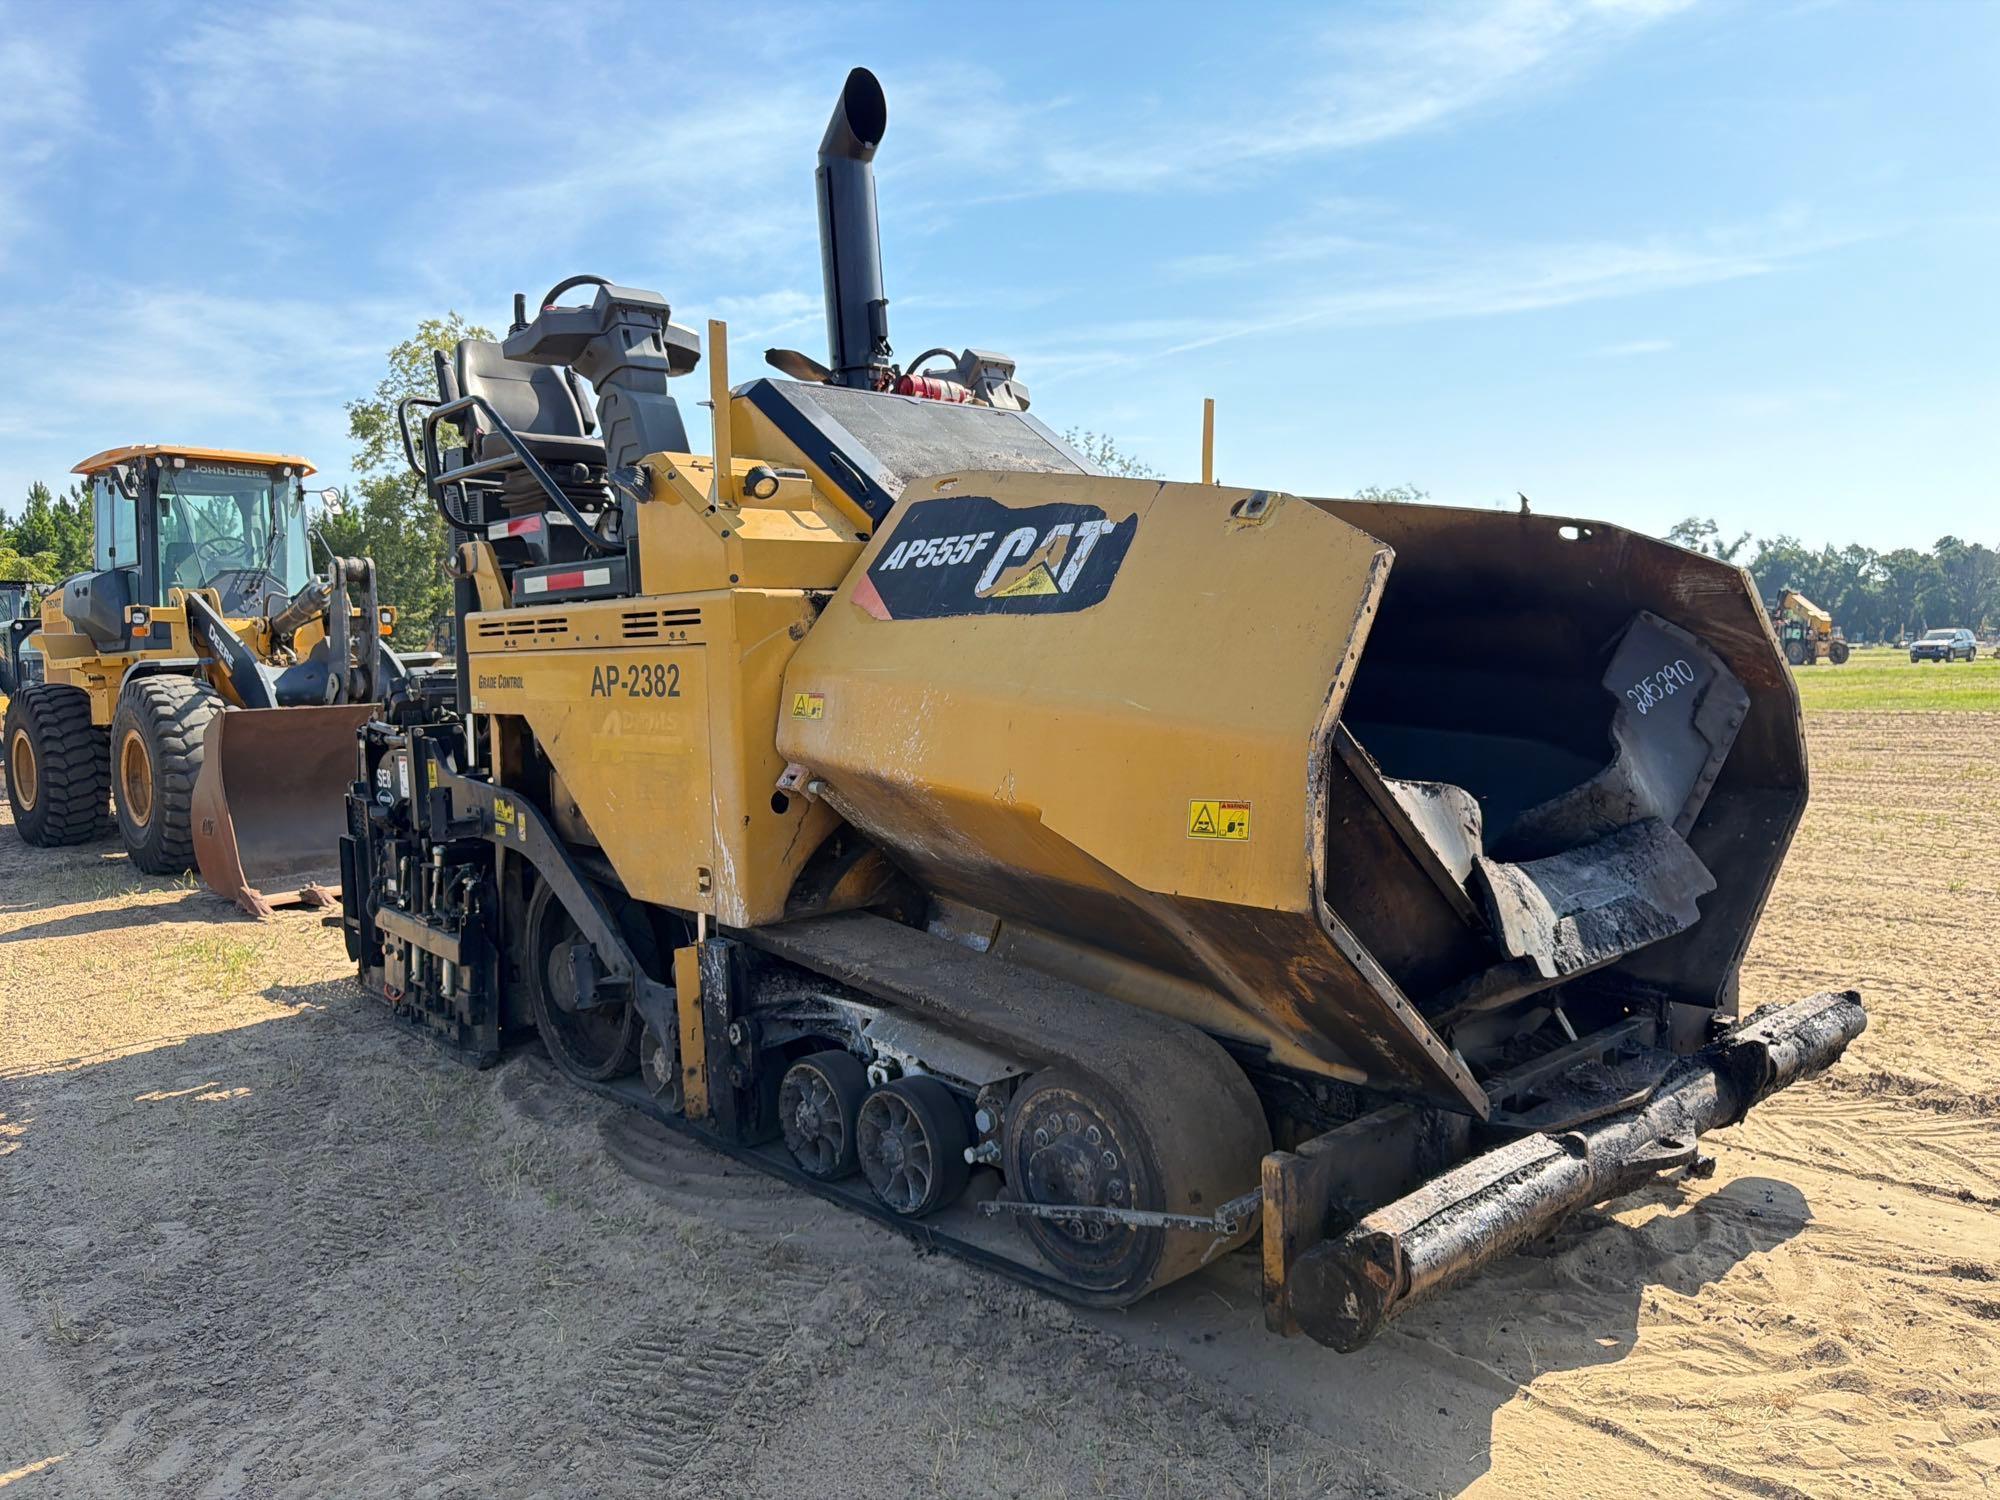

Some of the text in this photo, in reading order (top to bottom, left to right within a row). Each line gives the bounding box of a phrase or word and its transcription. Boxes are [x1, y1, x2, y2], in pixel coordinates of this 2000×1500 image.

[192, 464, 270, 479] JOHN DEERE
[879, 531, 995, 571] AP555F
[208, 623, 235, 671] DEERE
[591, 663, 681, 697] AP-2382
